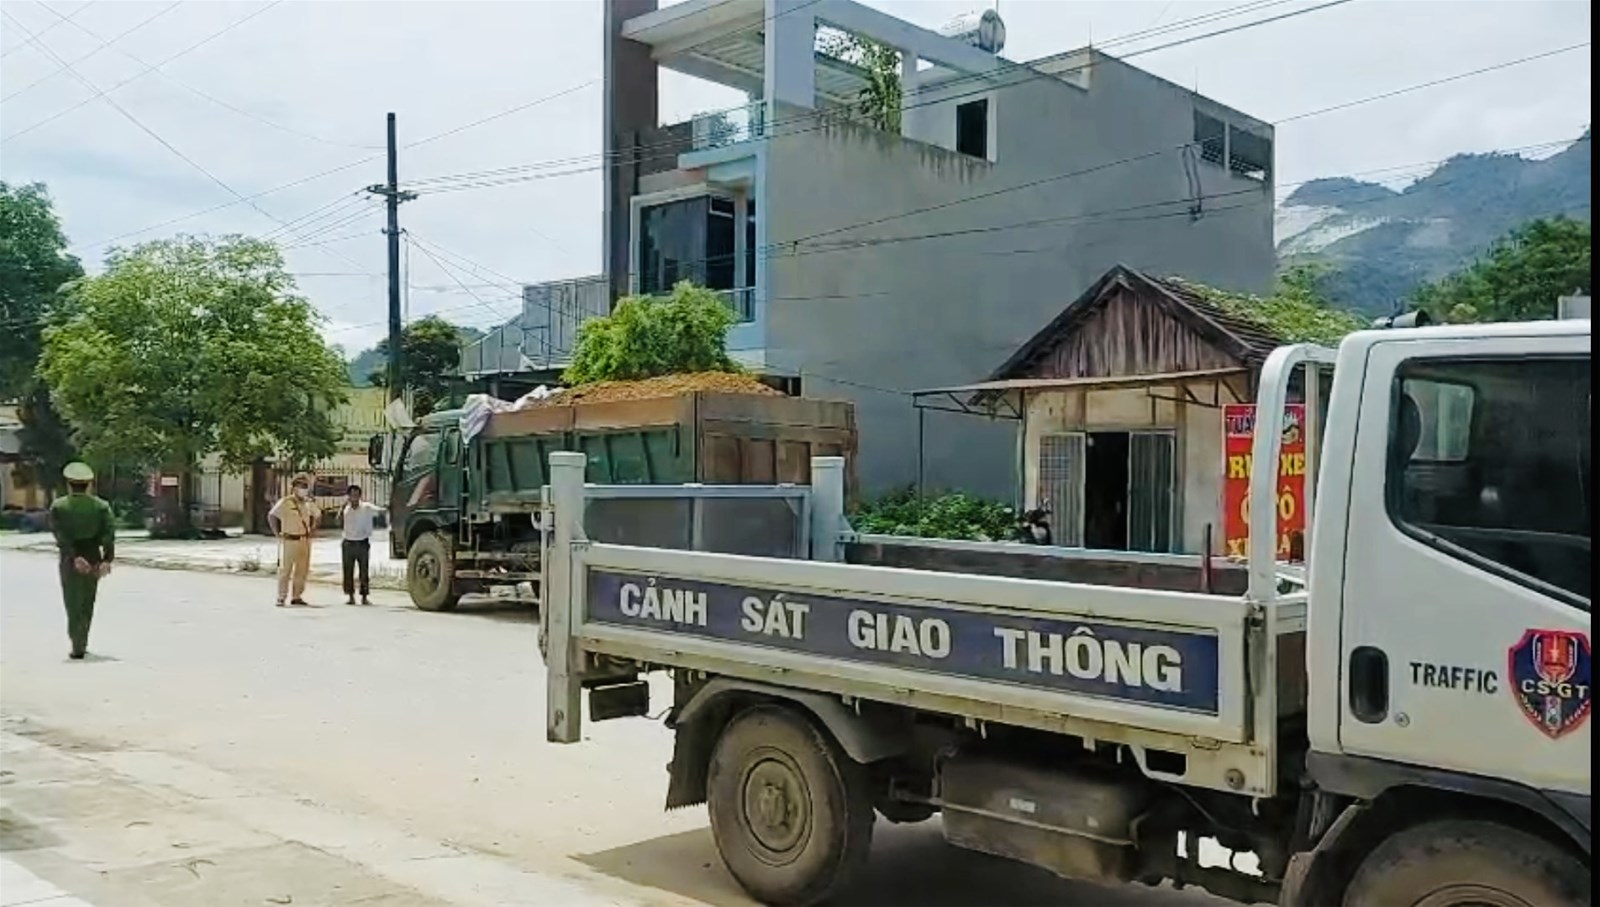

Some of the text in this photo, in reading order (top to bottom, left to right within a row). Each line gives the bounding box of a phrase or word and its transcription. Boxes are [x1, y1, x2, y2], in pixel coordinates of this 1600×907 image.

[620, 578, 1182, 693] CẢNH SÁT GIAO THÔNG
[1410, 662, 1498, 694] TRAFFIC
[1522, 679, 1589, 699] CSGT
